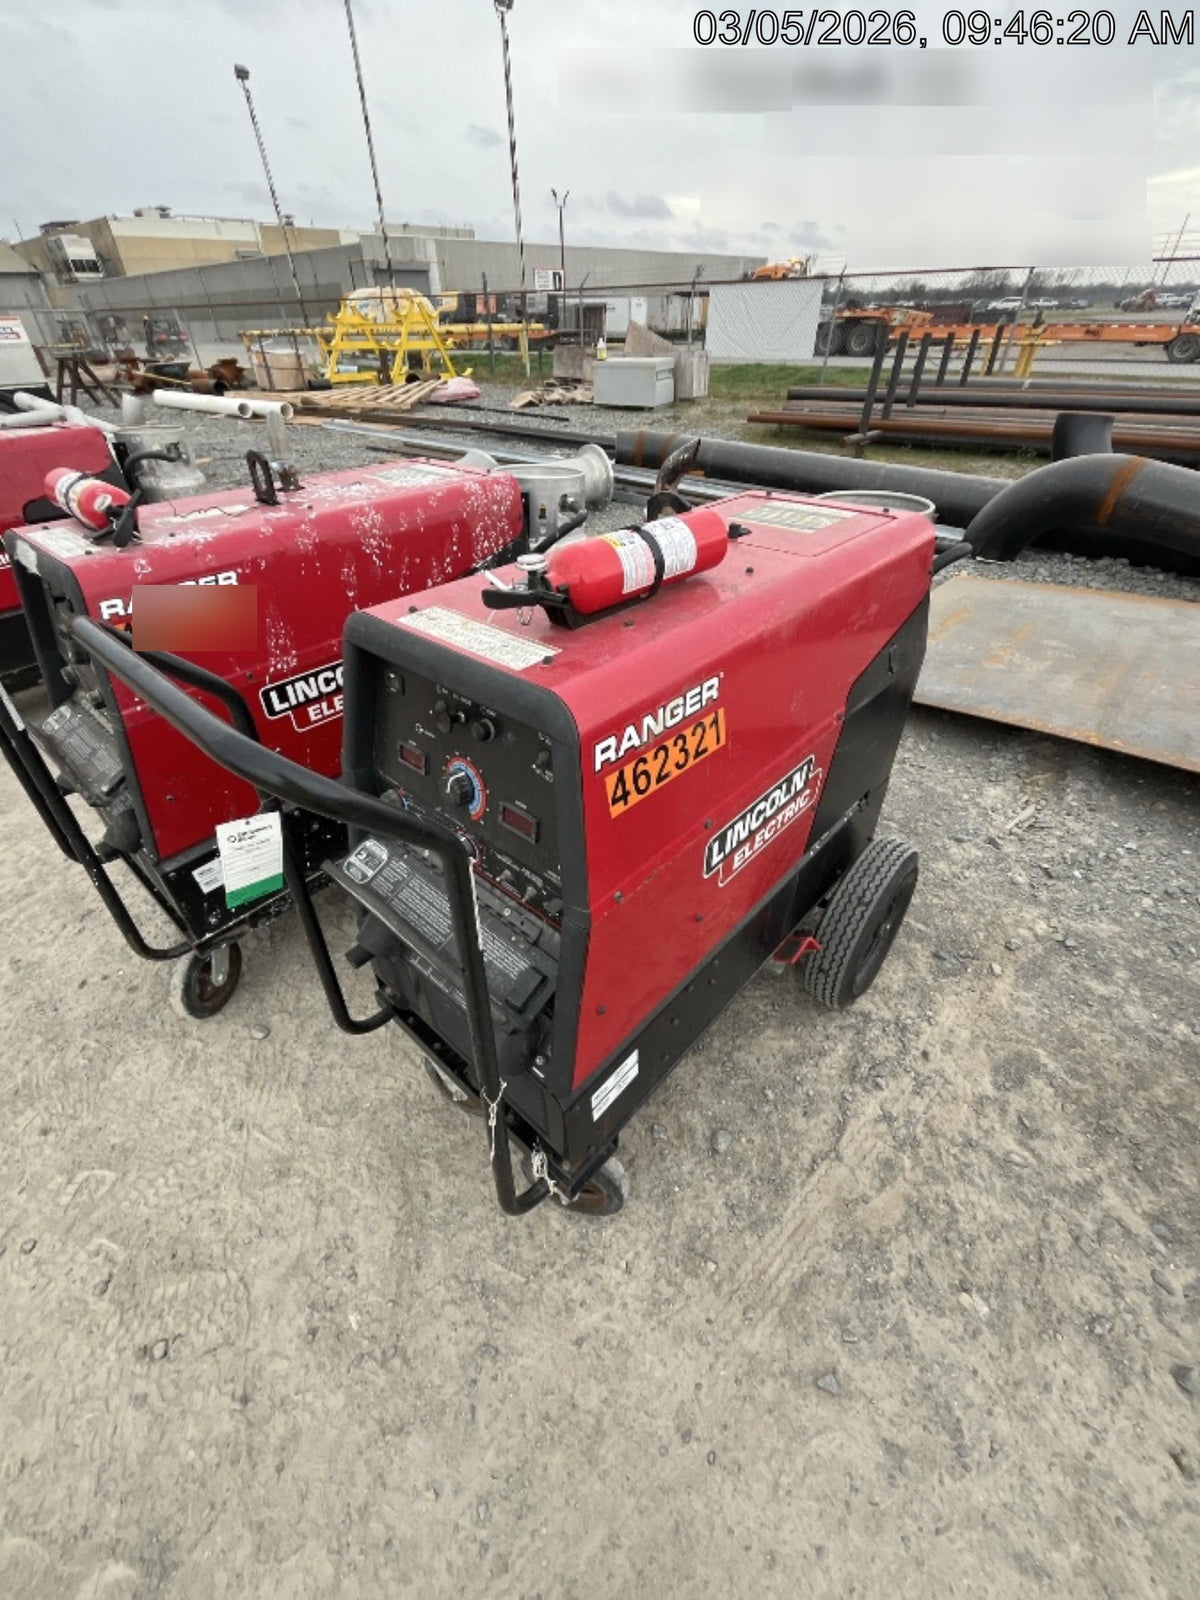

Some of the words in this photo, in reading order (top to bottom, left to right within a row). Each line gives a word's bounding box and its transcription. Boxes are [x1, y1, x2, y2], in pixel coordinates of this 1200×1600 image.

[594, 676, 720, 773] RANGER
[611, 710, 722, 807] 462321
[711, 764, 808, 867] LINCOLN
[732, 788, 811, 871] ELECTRIC
